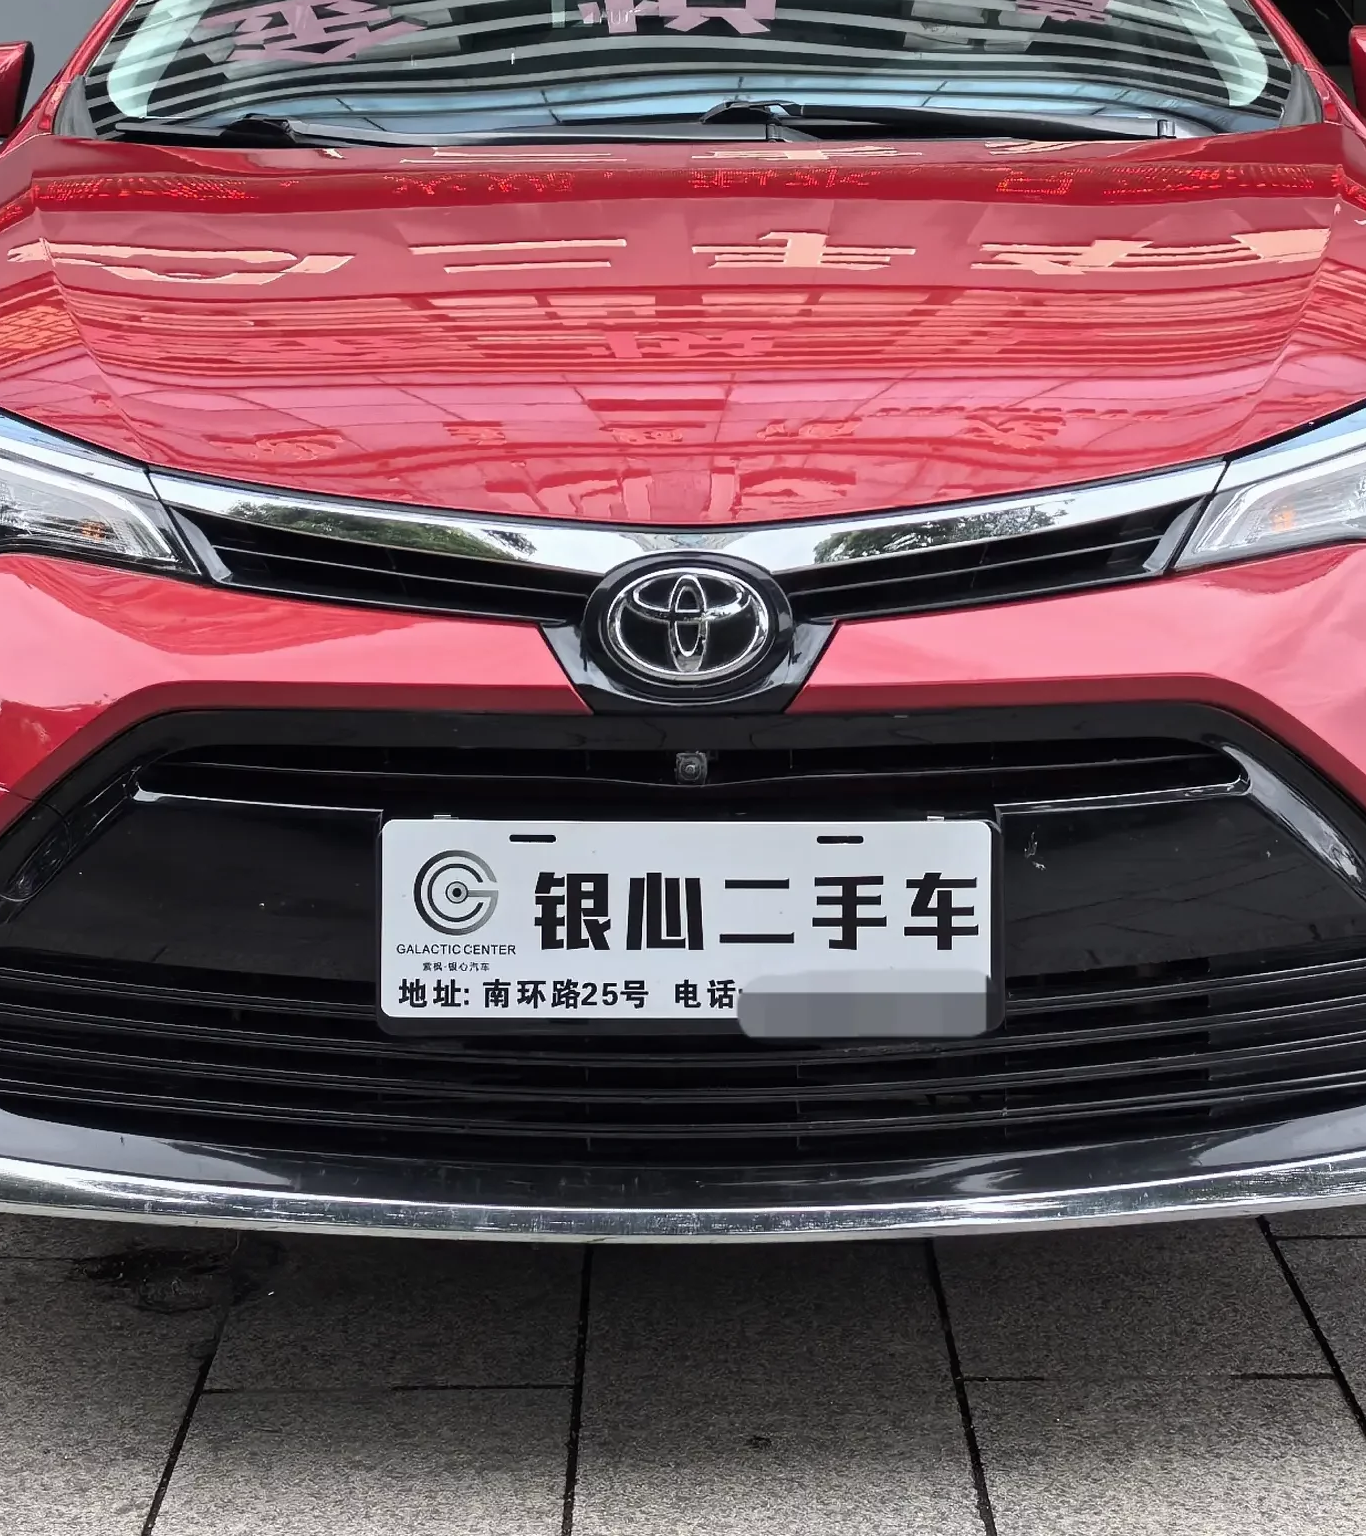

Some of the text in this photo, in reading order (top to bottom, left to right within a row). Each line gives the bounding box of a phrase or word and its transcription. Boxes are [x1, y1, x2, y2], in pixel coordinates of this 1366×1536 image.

[533, 870, 979, 951] 银心二手车
[396, 943, 517, 956] GALACTIC CENTER
